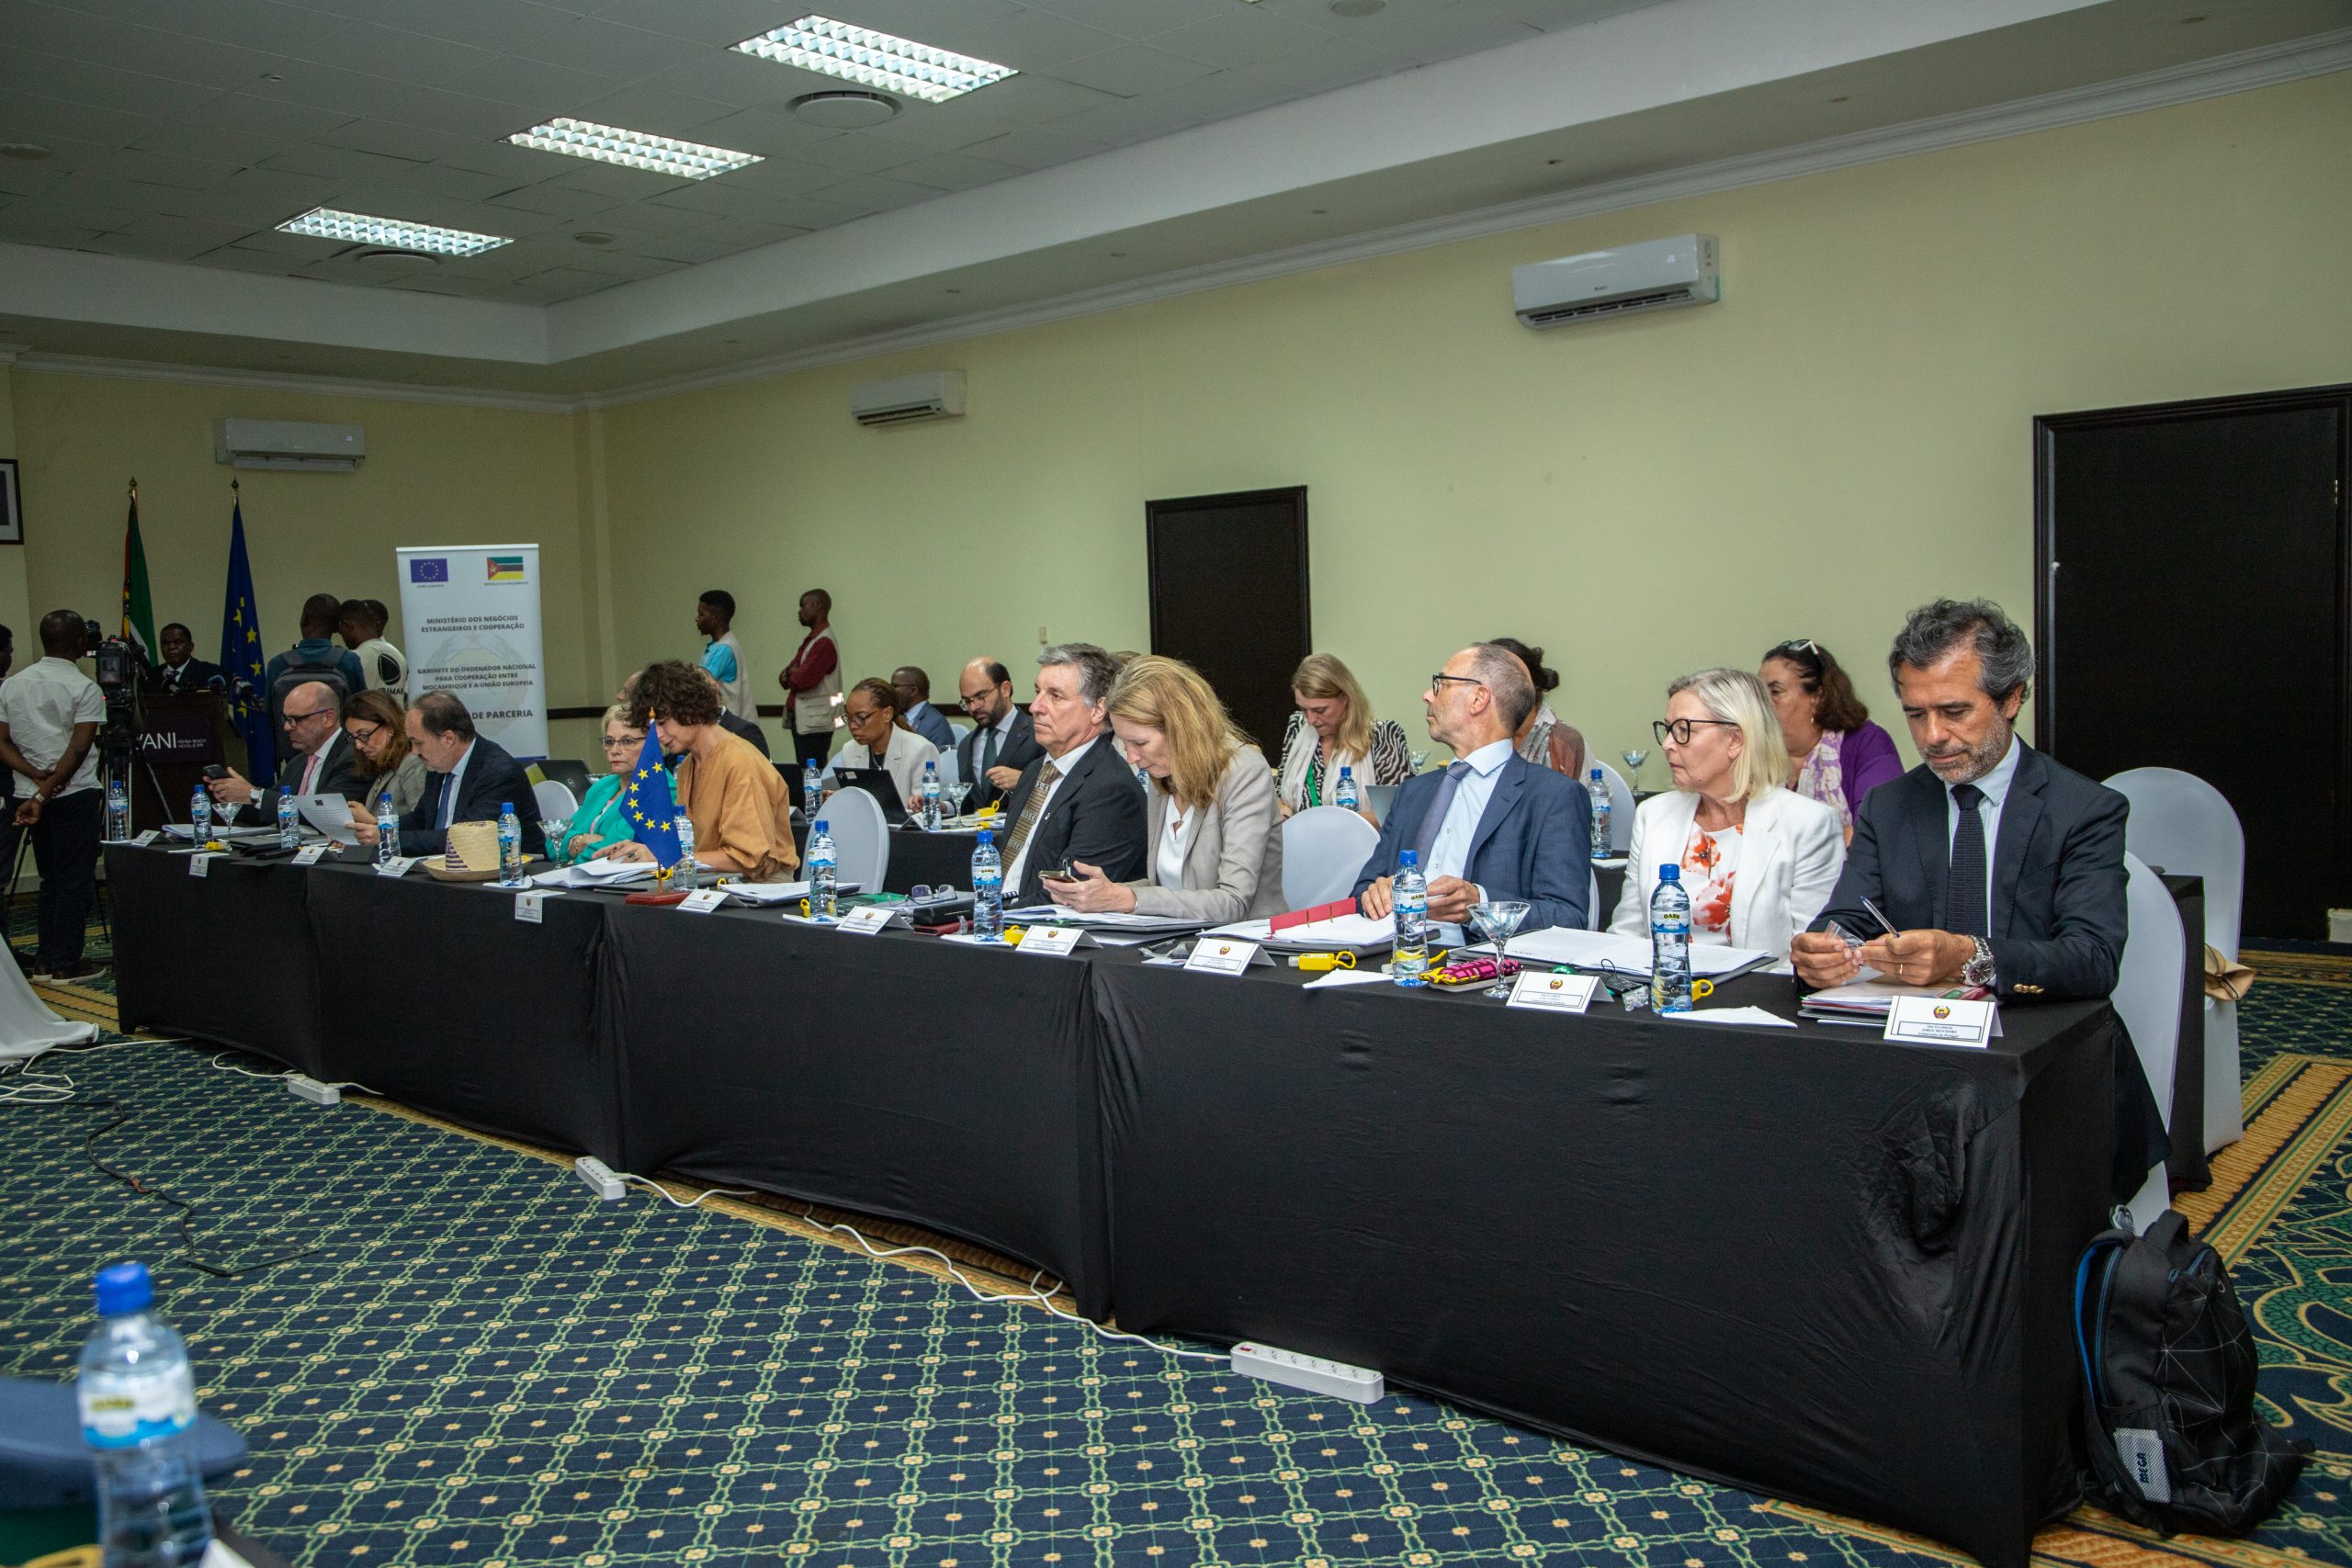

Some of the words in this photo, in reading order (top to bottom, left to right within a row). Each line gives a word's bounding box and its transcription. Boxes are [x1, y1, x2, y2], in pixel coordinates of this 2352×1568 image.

[426, 616, 467, 625] MINISTÉRIO
[479, 622, 525, 630] COOPERAÇÃO
[454, 672, 497, 682] COOPERAÇÃO
[486, 709, 533, 719] PARCERIA
